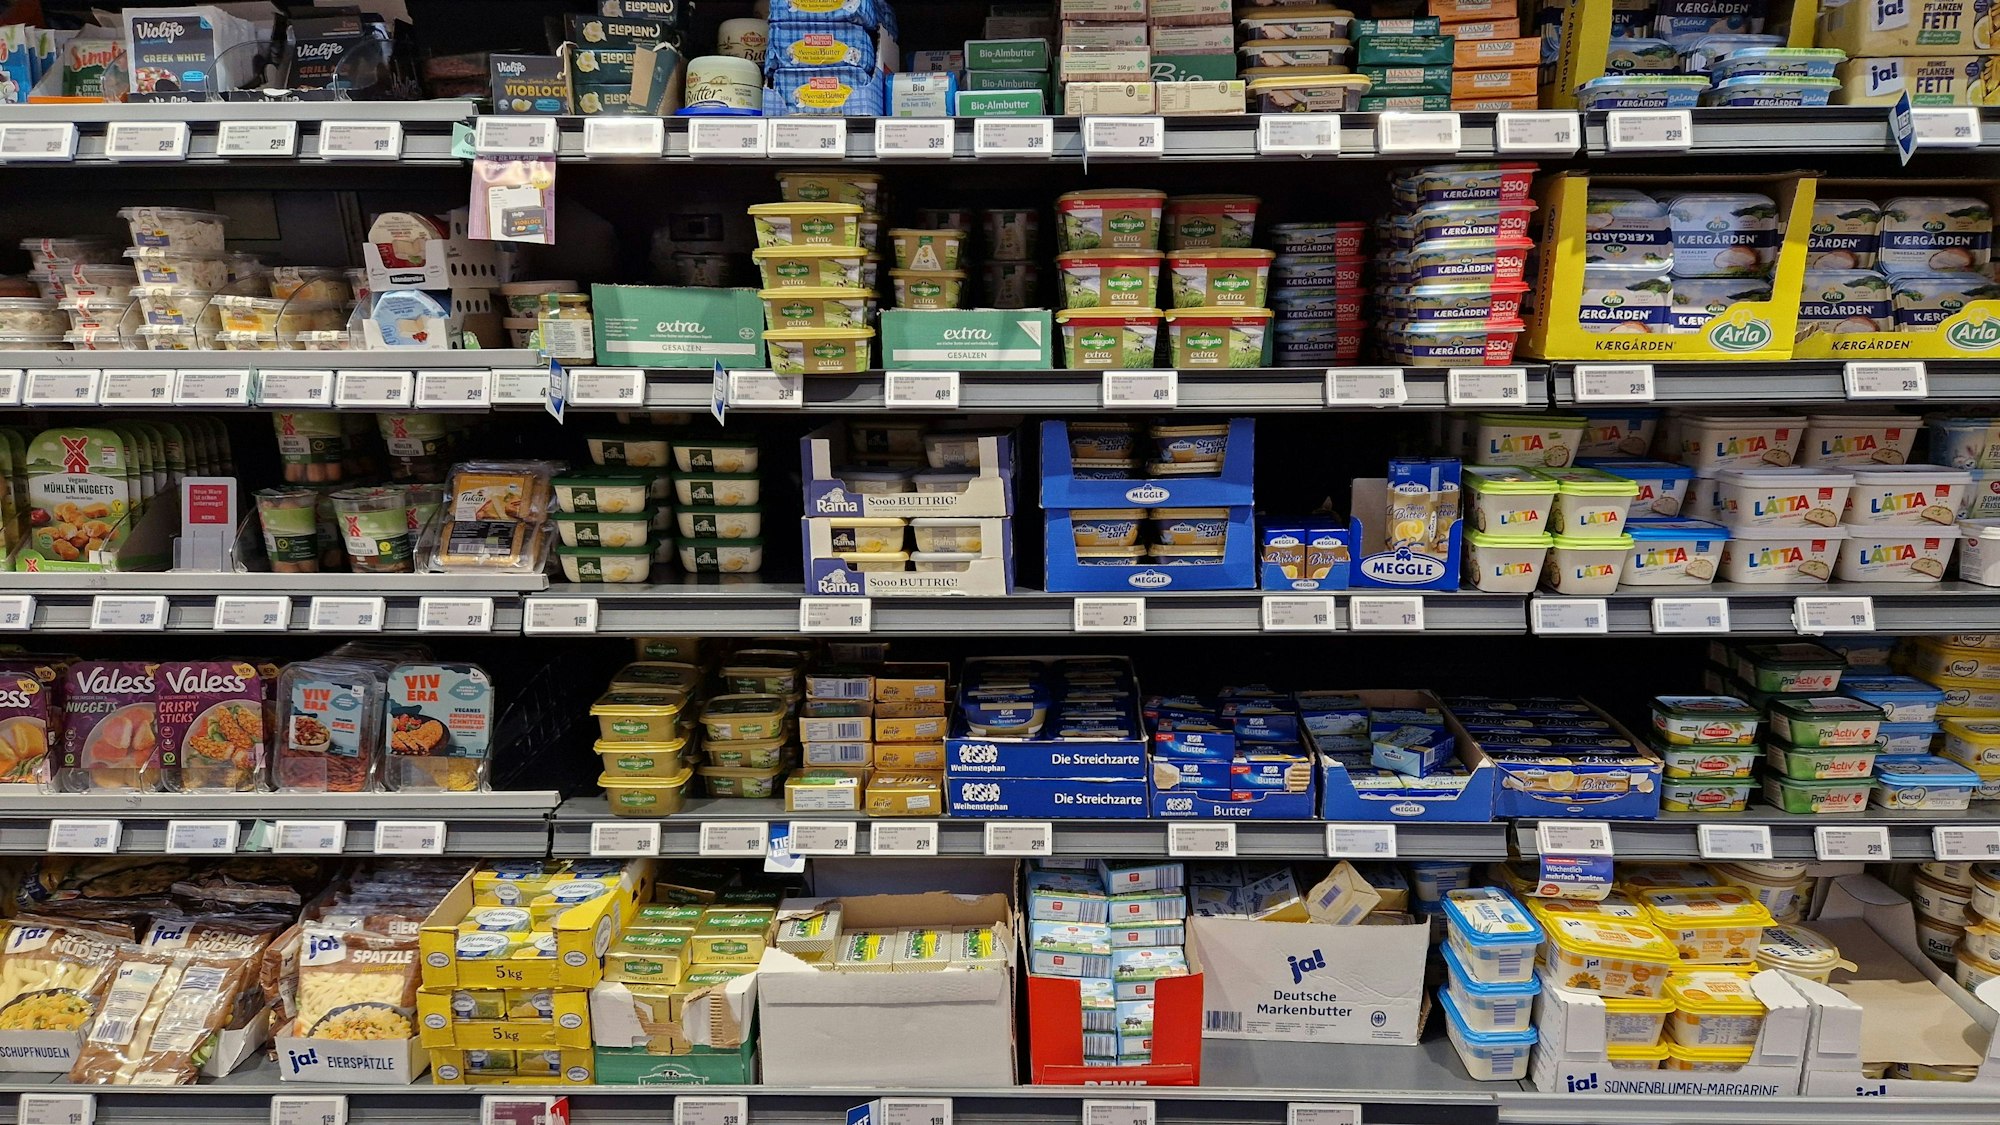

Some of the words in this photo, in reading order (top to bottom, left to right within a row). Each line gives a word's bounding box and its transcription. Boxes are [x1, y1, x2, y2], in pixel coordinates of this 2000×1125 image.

[1924, 3, 1963, 11] PFLANZEN
[1922, 12, 1962, 29] FETT
[137, 21, 186, 44] Violife
[144, 54, 174, 62] GREEK
[177, 53, 206, 62] WHITE
[297, 42, 343, 62] Violife
[980, 49, 1035, 58] Bio-Almbutter
[497, 62, 526, 76] Violife
[1872, 62, 1898, 90] ja!
[982, 79, 1037, 88] Bio-Almbutter
[1917, 77, 1954, 93] FETT
[504, 85, 568, 97] VIOBLOCK
[971, 102, 1029, 110] Bio-Almbutter
[1666, 130, 1682, 140] 2.39
[270, 138, 286, 150] 2.99
[374, 140, 388, 150] 1.99
[1502, 181, 1528, 192] 350g
[1443, 188, 1498, 199] KÆRGÅRDEN
[1501, 218, 1526, 230] 350g
[1709, 221, 1727, 230] Arla
[1814, 224, 1832, 232] Arla
[1442, 225, 1496, 236] KÆRGÅRDEN
[1678, 233, 1755, 244] KÆRGÅRDEN
[1894, 234, 1972, 245] KÆRGÅRDEN
[1496, 257, 1522, 268] 350g
[1438, 264, 1493, 274] KÆRGÅRDEN
[1604, 296, 1622, 305] Arla
[1492, 301, 1518, 312] 350g
[1434, 308, 1489, 318] KÆRGÅRDEN
[656, 320, 704, 333] extra
[1956, 324, 1996, 339] Arla
[944, 328, 992, 340] extra
[1720, 326, 1761, 344] Arla
[662, 344, 702, 352] GESALZEN
[1487, 340, 1513, 351] 350g
[1595, 338, 1674, 351] KÆRGÅRDEN
[1832, 339, 1910, 350] KÆRGÅRDEN
[947, 351, 987, 360] GESALZEN
[74, 388, 88, 398] 1.99
[386, 390, 400, 400] 2.99
[466, 390, 482, 400] 2.49
[936, 390, 950, 400] 4.89
[1154, 390, 1168, 400] 4.89
[1502, 388, 1518, 398] 3.89
[1629, 384, 1644, 395] 2.39
[1491, 434, 1543, 454] LÄTTA
[1718, 436, 1767, 456] LÄTTA
[1822, 435, 1877, 455] LÄTTA
[44, 481, 75, 494] MÜHLEN
[78, 483, 114, 495] NUGGETS
[1132, 490, 1163, 499] MEGGLE
[816, 500, 858, 513] Rama
[868, 497, 896, 506] Sooo
[899, 496, 957, 506] BUTTRIG!
[1755, 496, 1809, 516] LÄTTA
[1872, 493, 1926, 514] LÄTTA
[1394, 509, 1426, 519] Butter
[1501, 510, 1538, 524] LÄTTA
[1580, 511, 1617, 525] LÄTTA
[1098, 523, 1133, 533] Streich
[1108, 528, 1128, 538] zart
[833, 538, 854, 546] Rama
[1636, 548, 1687, 568] LÄTTA
[1749, 547, 1803, 568] LÄTTA
[1860, 545, 1916, 565] LÄTTA
[1373, 562, 1433, 575] MEGGLE
[1496, 563, 1532, 576] LÄTTA
[1576, 564, 1613, 578] LÄTTA
[870, 578, 897, 587] Sooo
[900, 577, 958, 587] BUTTRIG!
[1135, 575, 1166, 584] MEGGLE
[818, 580, 859, 594] Rama
[1122, 616, 1136, 626] 2.79
[1954, 664, 1975, 672] Becel
[76, 667, 155, 694] Valess
[166, 666, 246, 693] Valess
[404, 675, 440, 689] VIV
[303, 689, 331, 701] VIV
[407, 690, 438, 702] ERA
[66, 702, 118, 713] NUGGETS
[159, 701, 199, 713] CRISPY
[304, 701, 329, 711] ERA
[160, 714, 193, 723] STICKS
[1819, 728, 1859, 739] ProActiv
[1181, 745, 1207, 753] Butter
[1052, 754, 1071, 764] Die
[1073, 754, 1140, 764] Streichzarte
[950, 764, 1006, 773] Weihenstephan
[1815, 761, 1855, 772] ProActiv
[1258, 776, 1284, 784] Butter
[1582, 780, 1616, 790] Butter
[1055, 793, 1074, 803] Die
[1076, 794, 1142, 805] Streichzarte
[1811, 793, 1851, 804] ProActiv
[954, 803, 1008, 811] Weihenstephan
[1214, 806, 1252, 816] Butter
[834, 840, 848, 850] 2.59
[916, 840, 930, 850] 2.79
[1546, 865, 1582, 873] Wöchentlich
[643, 909, 697, 918] Kerrygold
[709, 917, 764, 926] Kerrygold
[14, 927, 49, 947] ja!
[152, 924, 186, 946] ja!
[1288, 949, 1326, 984] ja!
[1586, 959, 1600, 968] ja!
[120, 969, 133, 978] ja!
[496, 965, 505, 978] 5
[508, 969, 522, 980] kg
[1274, 990, 1337, 1002] Deutsche
[1257, 1003, 1352, 1017] Markenbutter
[493, 1028, 502, 1039] 5
[504, 1030, 519, 1042] kg
[0, 1046, 70, 1058] SCHUPFNUDELN
[288, 1048, 318, 1074] ja!
[327, 1055, 394, 1070] EIERSPÄTZLE
[1566, 1073, 1598, 1092] ja!
[1604, 1080, 1779, 1096] SONNENBLUMEN-MARGARINE
